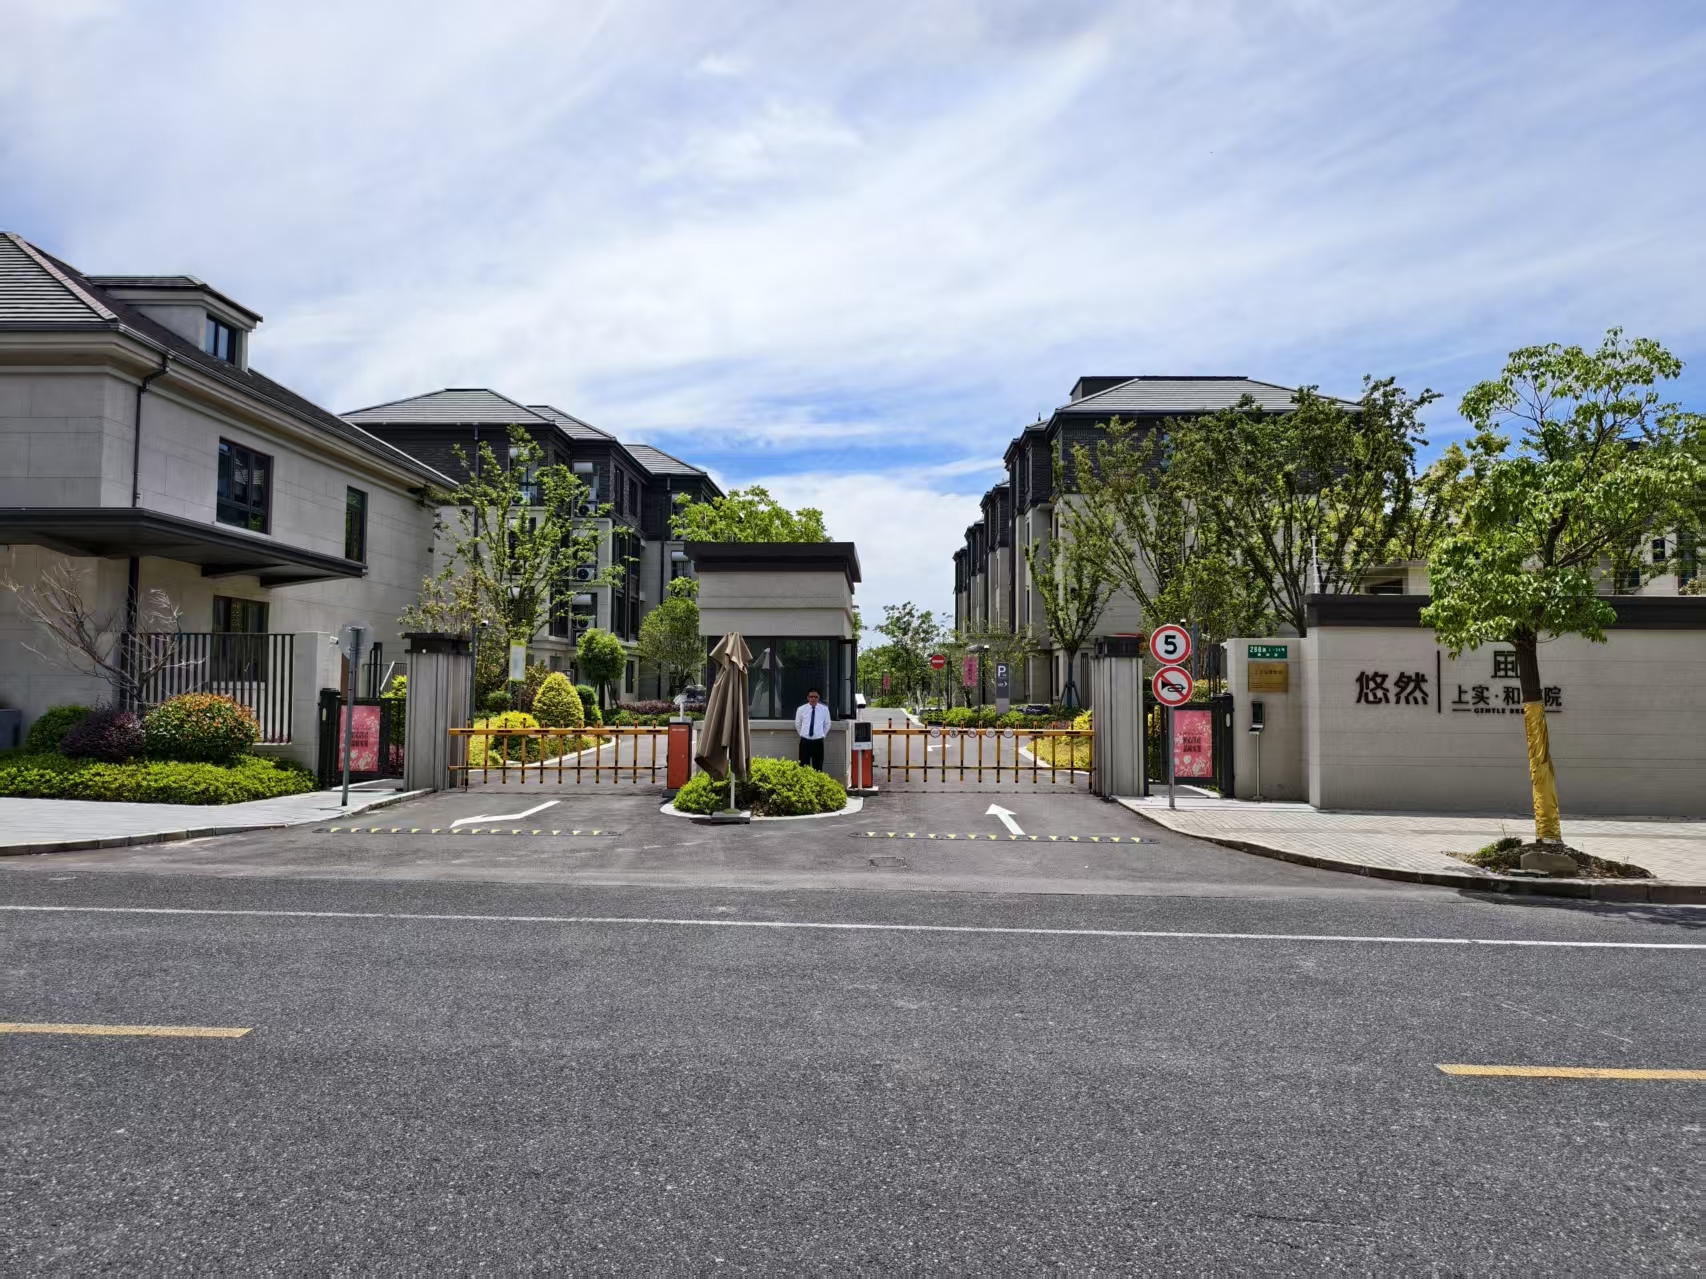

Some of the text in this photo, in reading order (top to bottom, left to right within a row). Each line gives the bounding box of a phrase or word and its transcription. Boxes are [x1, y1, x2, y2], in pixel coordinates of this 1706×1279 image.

[1164, 634, 1178, 655] 5
[997, 665, 1006, 677] P
[1355, 671, 1430, 705] 悠然
[1451, 684, 1563, 707] 上实·和院
